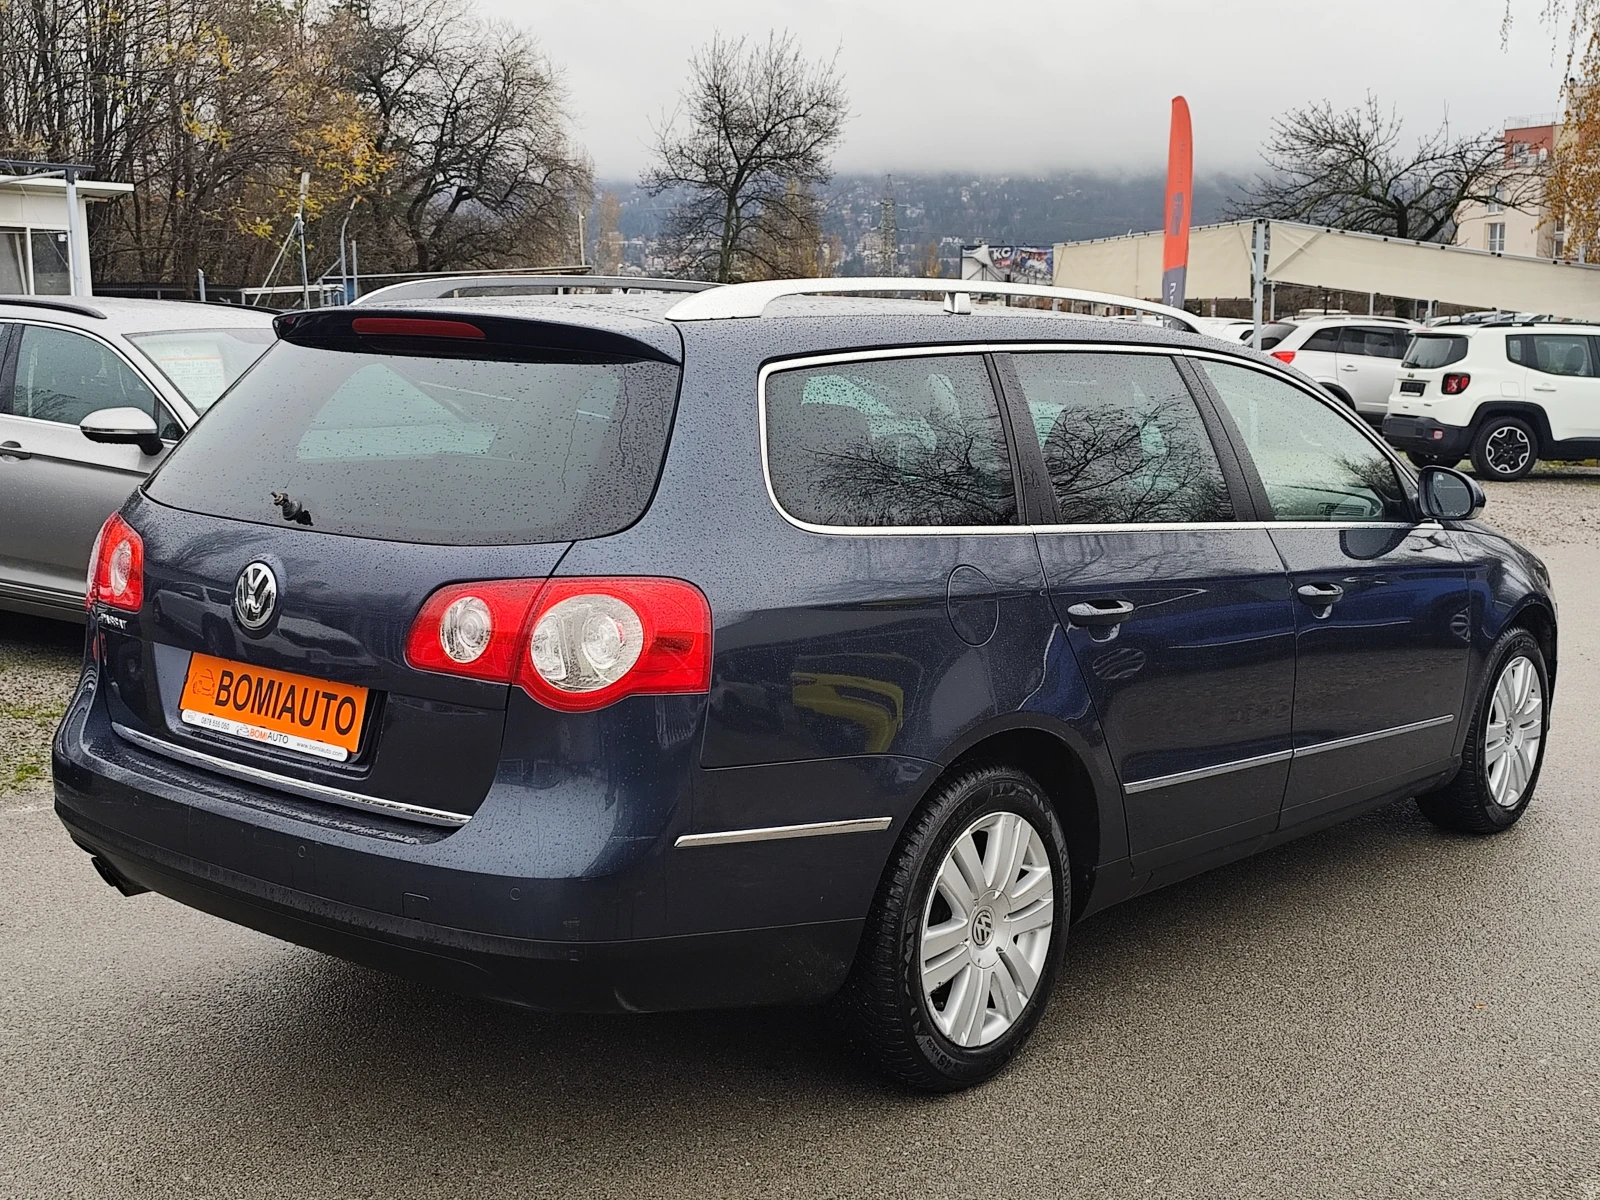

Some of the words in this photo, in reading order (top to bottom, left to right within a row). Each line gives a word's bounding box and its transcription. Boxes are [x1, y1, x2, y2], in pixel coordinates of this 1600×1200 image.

[215, 669, 357, 736] BOMIAUTO
[200, 716, 212, 726] 0878
[249, 727, 289, 745] BOMIAUTO
[296, 741, 344, 757] www.bomiauto.com
